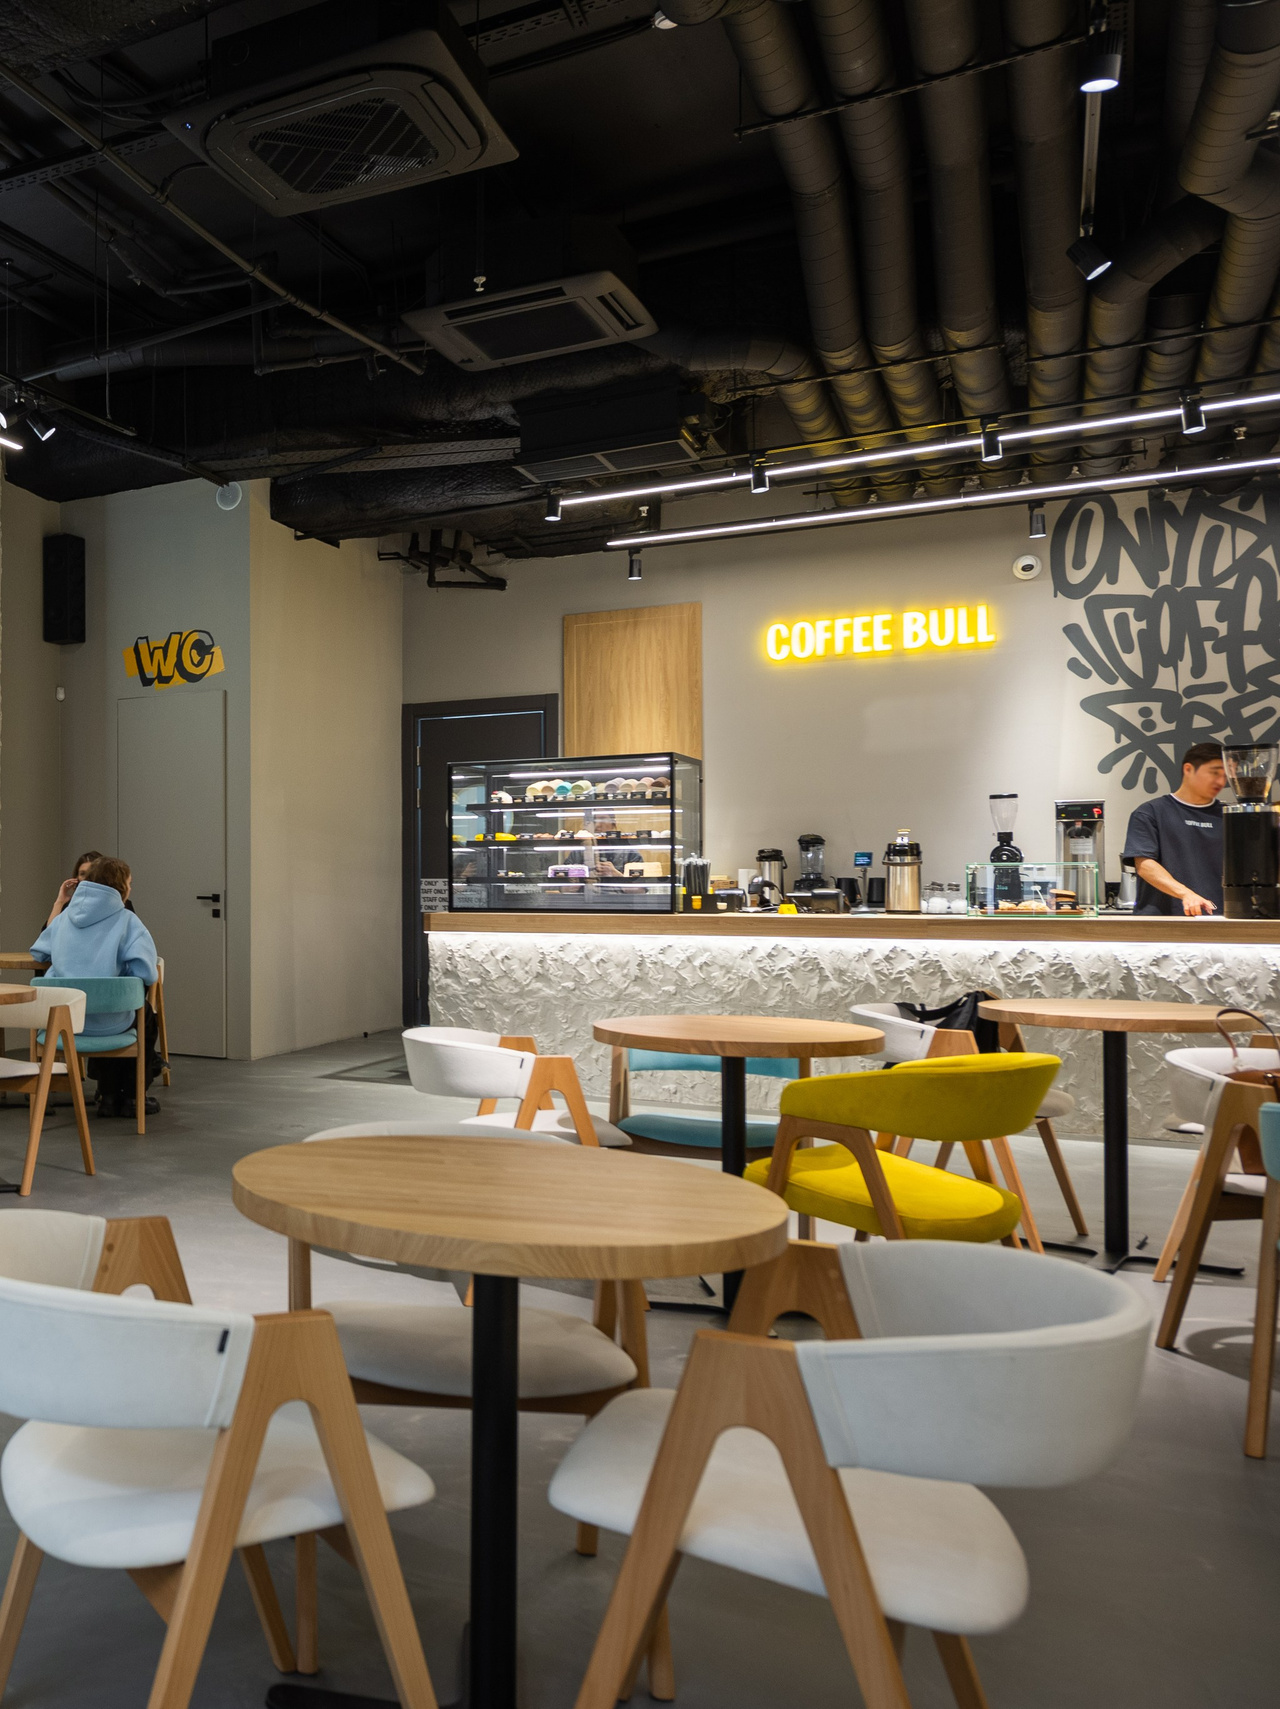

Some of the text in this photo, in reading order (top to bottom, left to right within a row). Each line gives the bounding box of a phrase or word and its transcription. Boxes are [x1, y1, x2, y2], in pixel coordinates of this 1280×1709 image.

[133, 629, 215, 687] WC
[766, 603, 996, 661] COFFEE BULL
